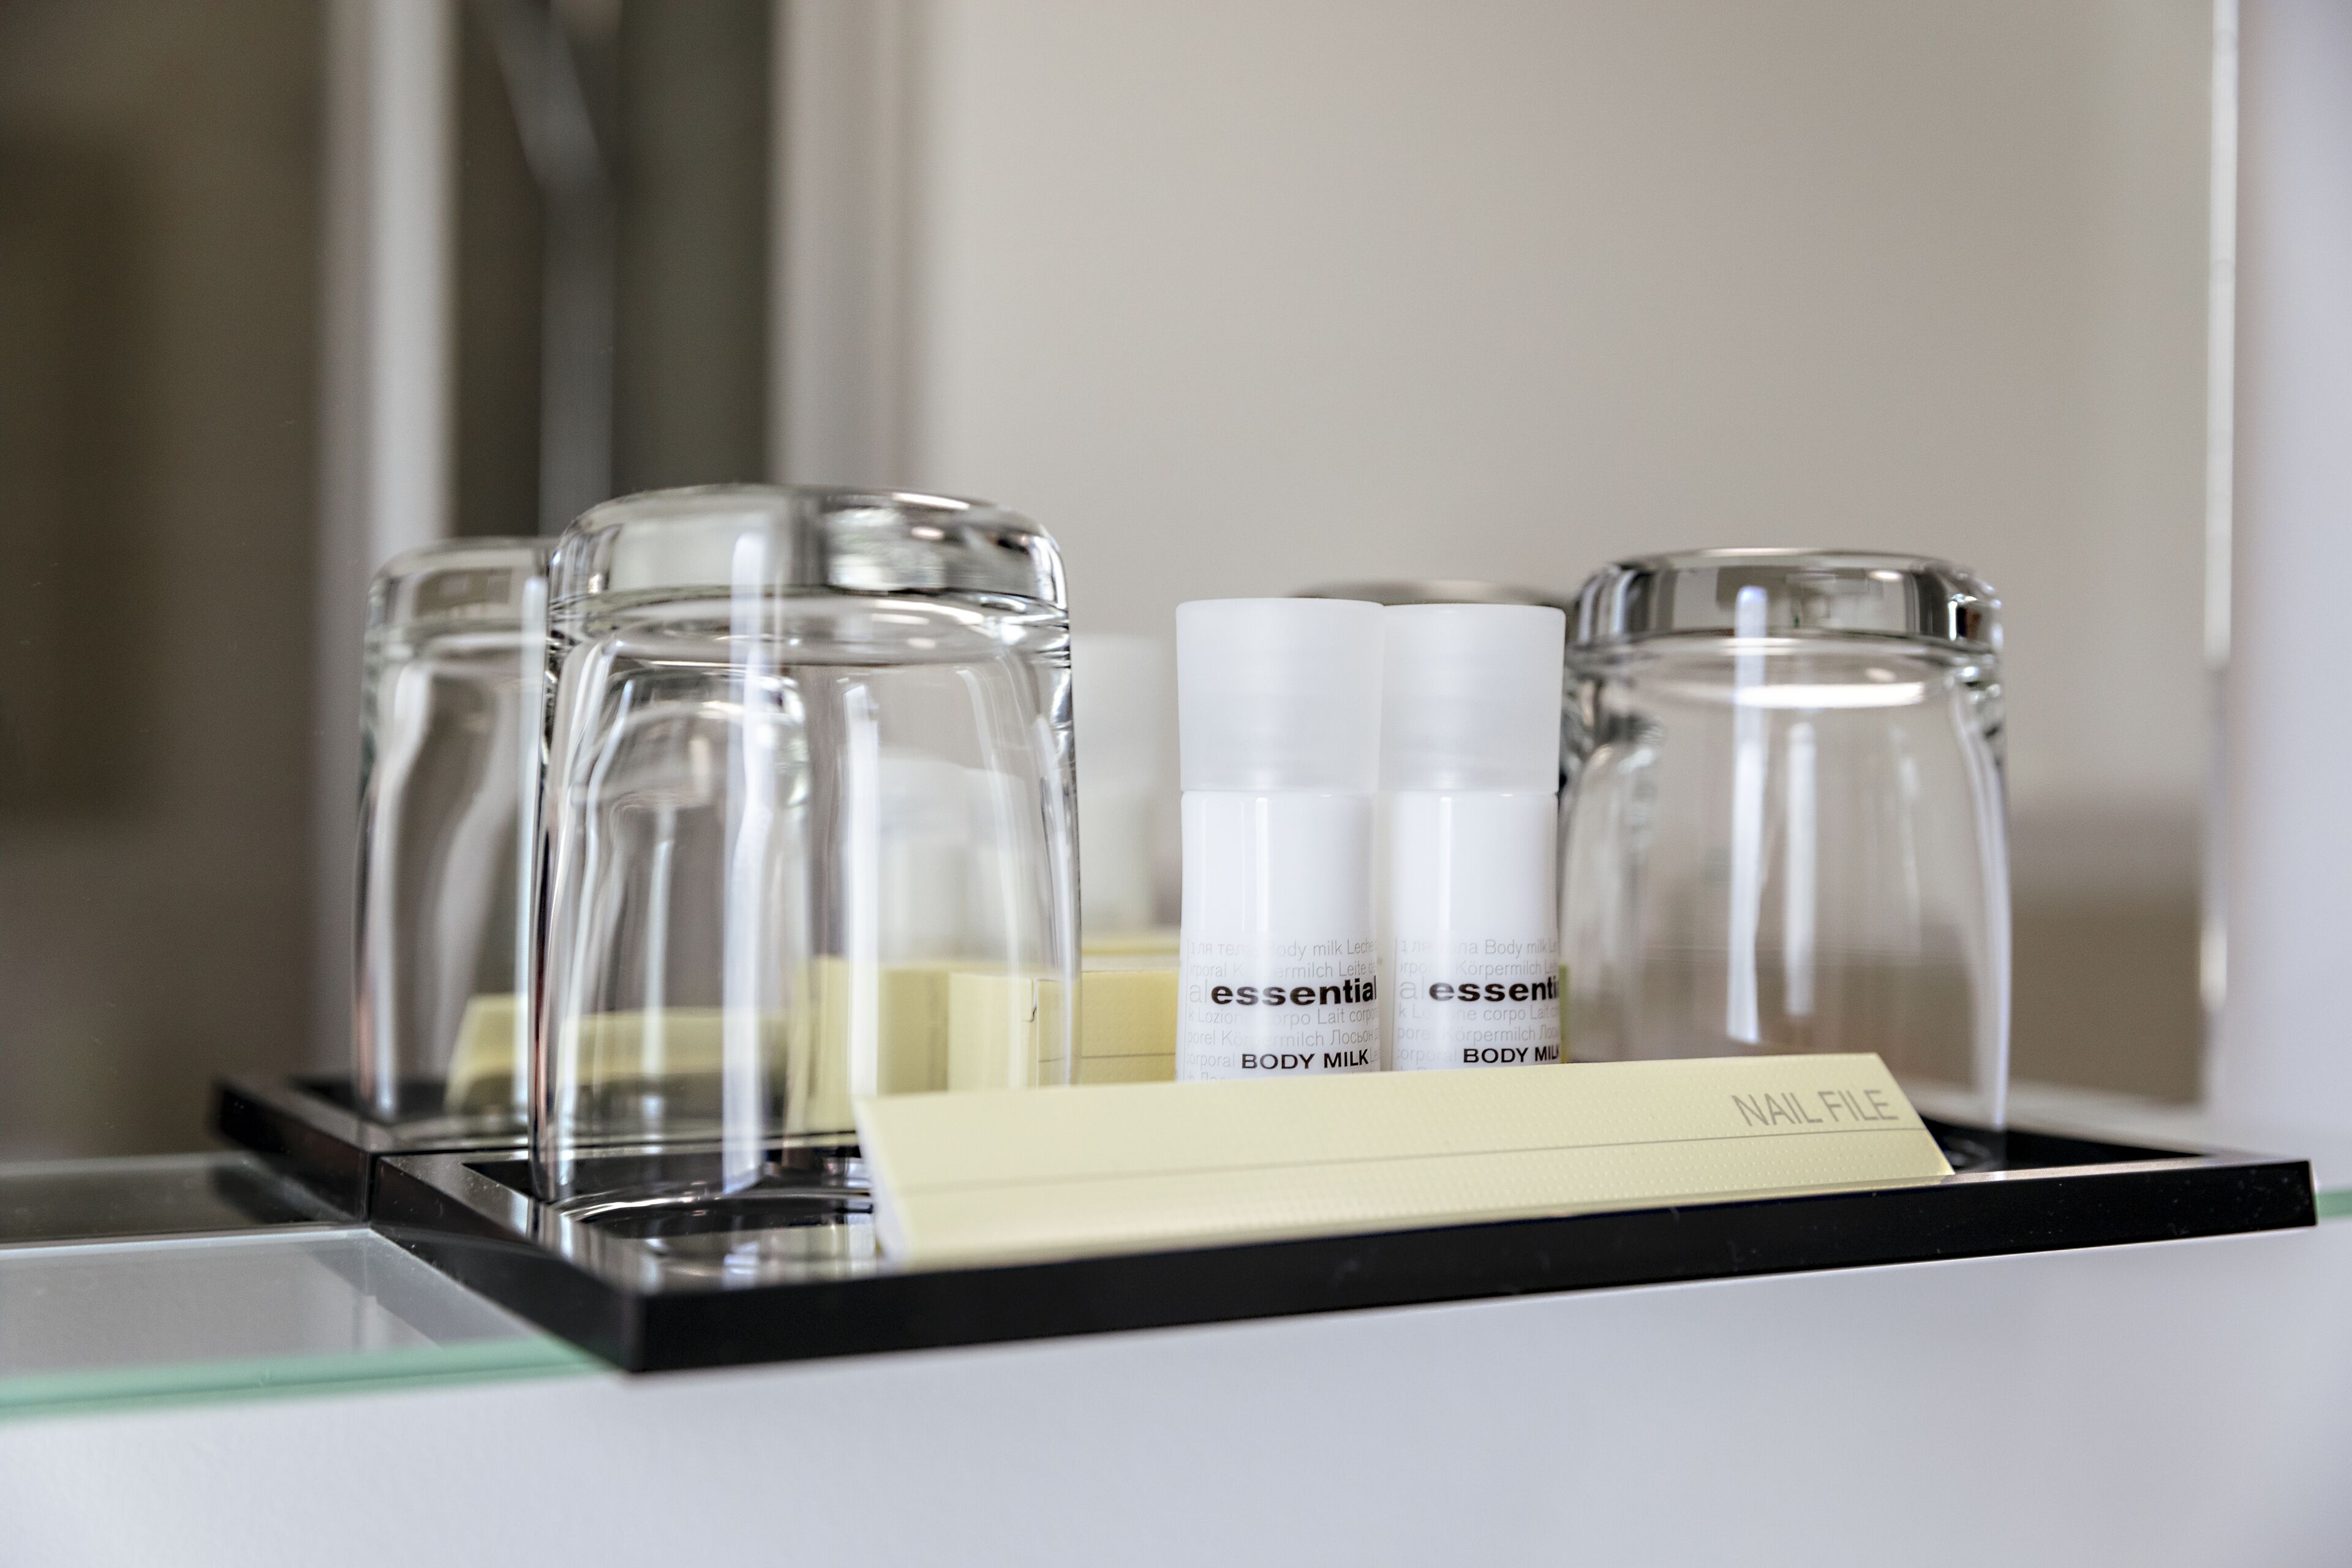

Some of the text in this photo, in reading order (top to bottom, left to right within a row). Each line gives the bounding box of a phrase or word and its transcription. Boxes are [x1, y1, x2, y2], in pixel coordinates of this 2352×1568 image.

[1217, 943, 1252, 957] тел
[1268, 940, 1307, 962] ody
[1313, 940, 1343, 957] milk
[1485, 938, 1523, 959] Body
[1339, 960, 1367, 978] Leite
[1455, 958, 1542, 980] Körpermilch
[1210, 974, 1378, 1007] essential
[1428, 974, 1559, 1003] essenti
[1197, 1008, 1252, 1025] Lozion
[1265, 1012, 1311, 1030] orpo
[1317, 1008, 1346, 1025] Lait
[1483, 1008, 1526, 1025] corpo
[1241, 1048, 1370, 1070] BODY MILK
[1463, 1047, 1529, 1064] BODY
[1731, 1089, 1899, 1127] NAIL FILE
